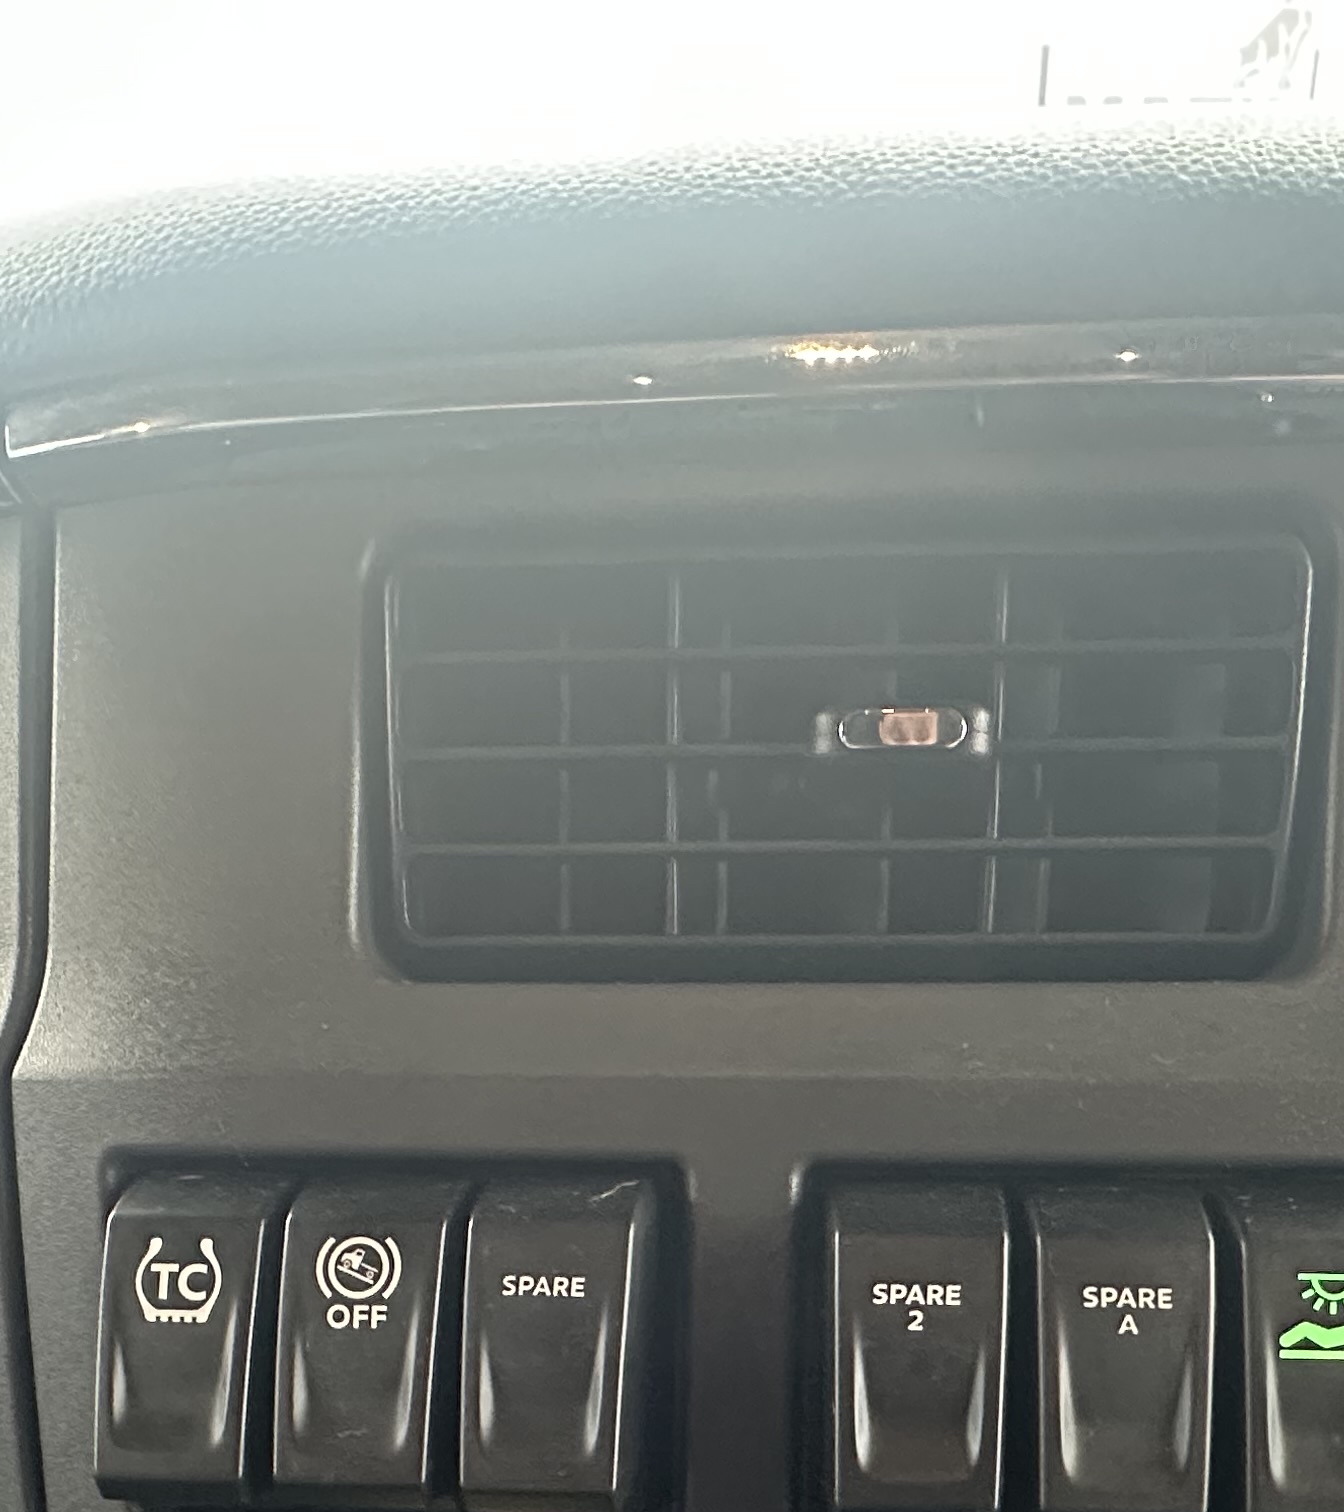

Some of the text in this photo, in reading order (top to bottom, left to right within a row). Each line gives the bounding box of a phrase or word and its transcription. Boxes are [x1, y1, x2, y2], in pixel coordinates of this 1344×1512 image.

[150, 1262, 209, 1301] TC
[501, 1275, 586, 1298] SPARE
[872, 1284, 962, 1306] SPARE
[1082, 1286, 1173, 1309] SPARE
[326, 1304, 388, 1329] OFF
[907, 1311, 924, 1331] 2
[1117, 1315, 1139, 1335] A
